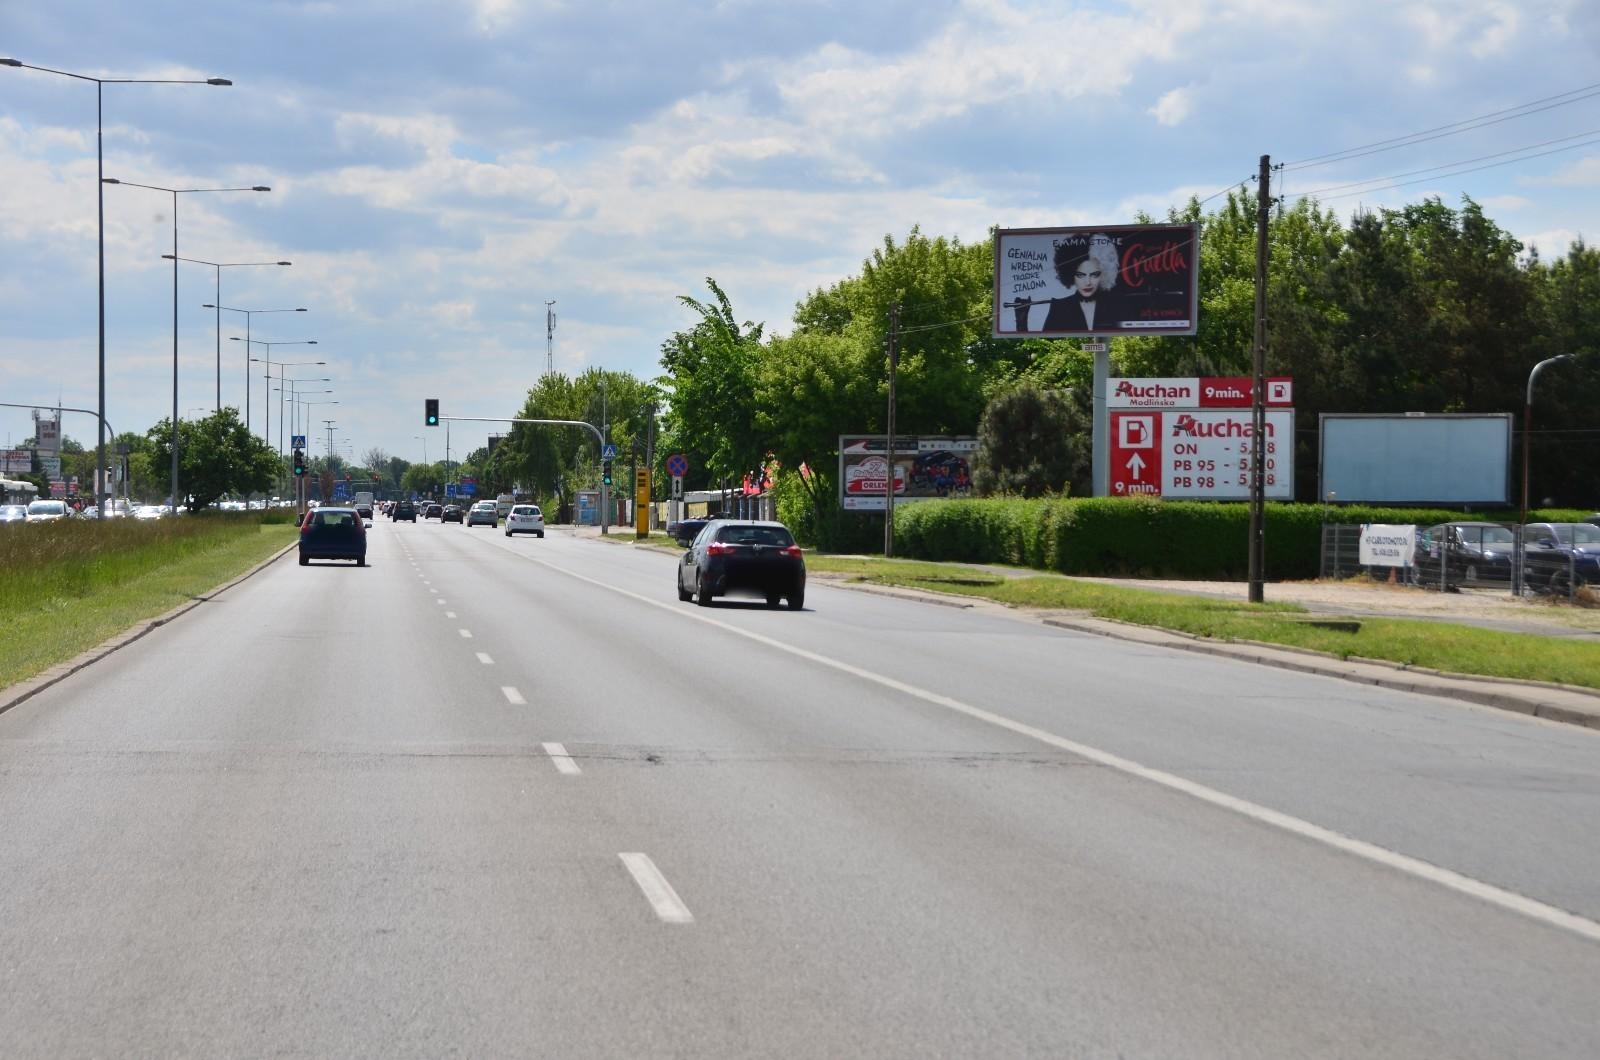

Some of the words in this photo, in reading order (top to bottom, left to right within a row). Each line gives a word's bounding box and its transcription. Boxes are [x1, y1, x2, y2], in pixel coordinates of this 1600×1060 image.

[1007, 247, 1048, 262] GENIALNA
[1011, 261, 1043, 271] WREDNA
[1012, 279, 1047, 293] SZALONA
[1114, 381, 1190, 398] Auchan
[1172, 414, 1274, 438] Auchan
[1173, 443, 1197, 455] ON
[1239, 442, 1275, 455] 5,8
[1173, 460, 1192, 471] PB
[1197, 460, 1215, 471] 95
[1239, 459, 1275, 472] 5,0
[1114, 481, 1124, 493] 9
[1173, 476, 1191, 488] PB
[1197, 476, 1215, 488] 98
[1238, 474, 1275, 489] 5,8
